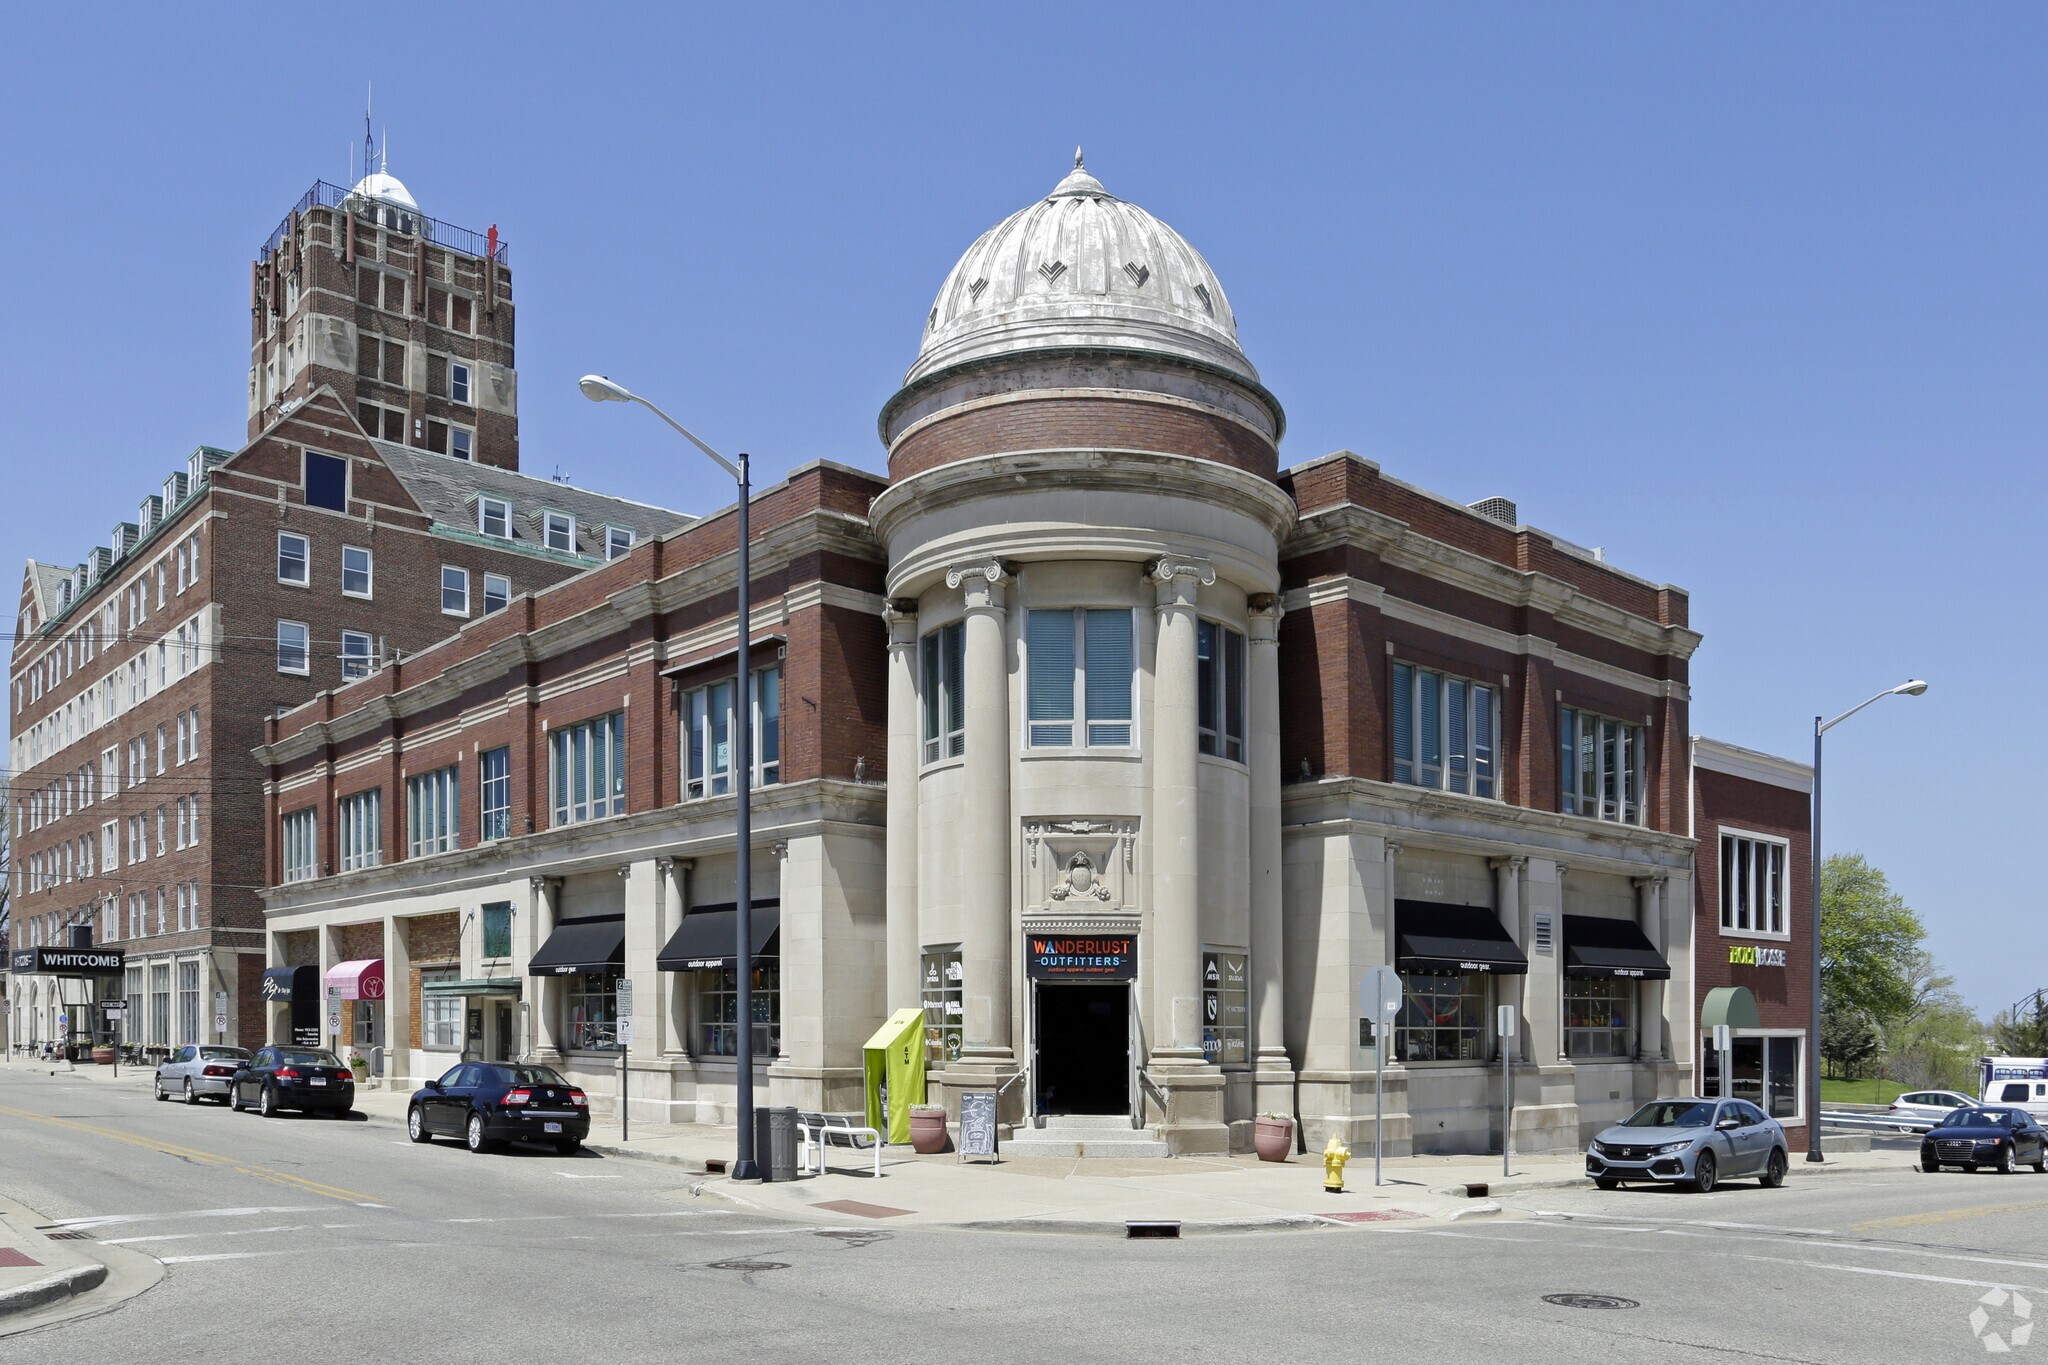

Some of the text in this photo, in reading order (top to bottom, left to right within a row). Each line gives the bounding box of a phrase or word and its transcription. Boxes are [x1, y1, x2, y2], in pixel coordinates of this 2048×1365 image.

[1034, 940, 1130, 954] WANDERLUST
[43, 953, 120, 967] WHITCOMB
[687, 960, 705, 968] outdoor
[1040, 957, 1120, 966] OUTFITTERS
[1460, 961, 1479, 969] outdoor
